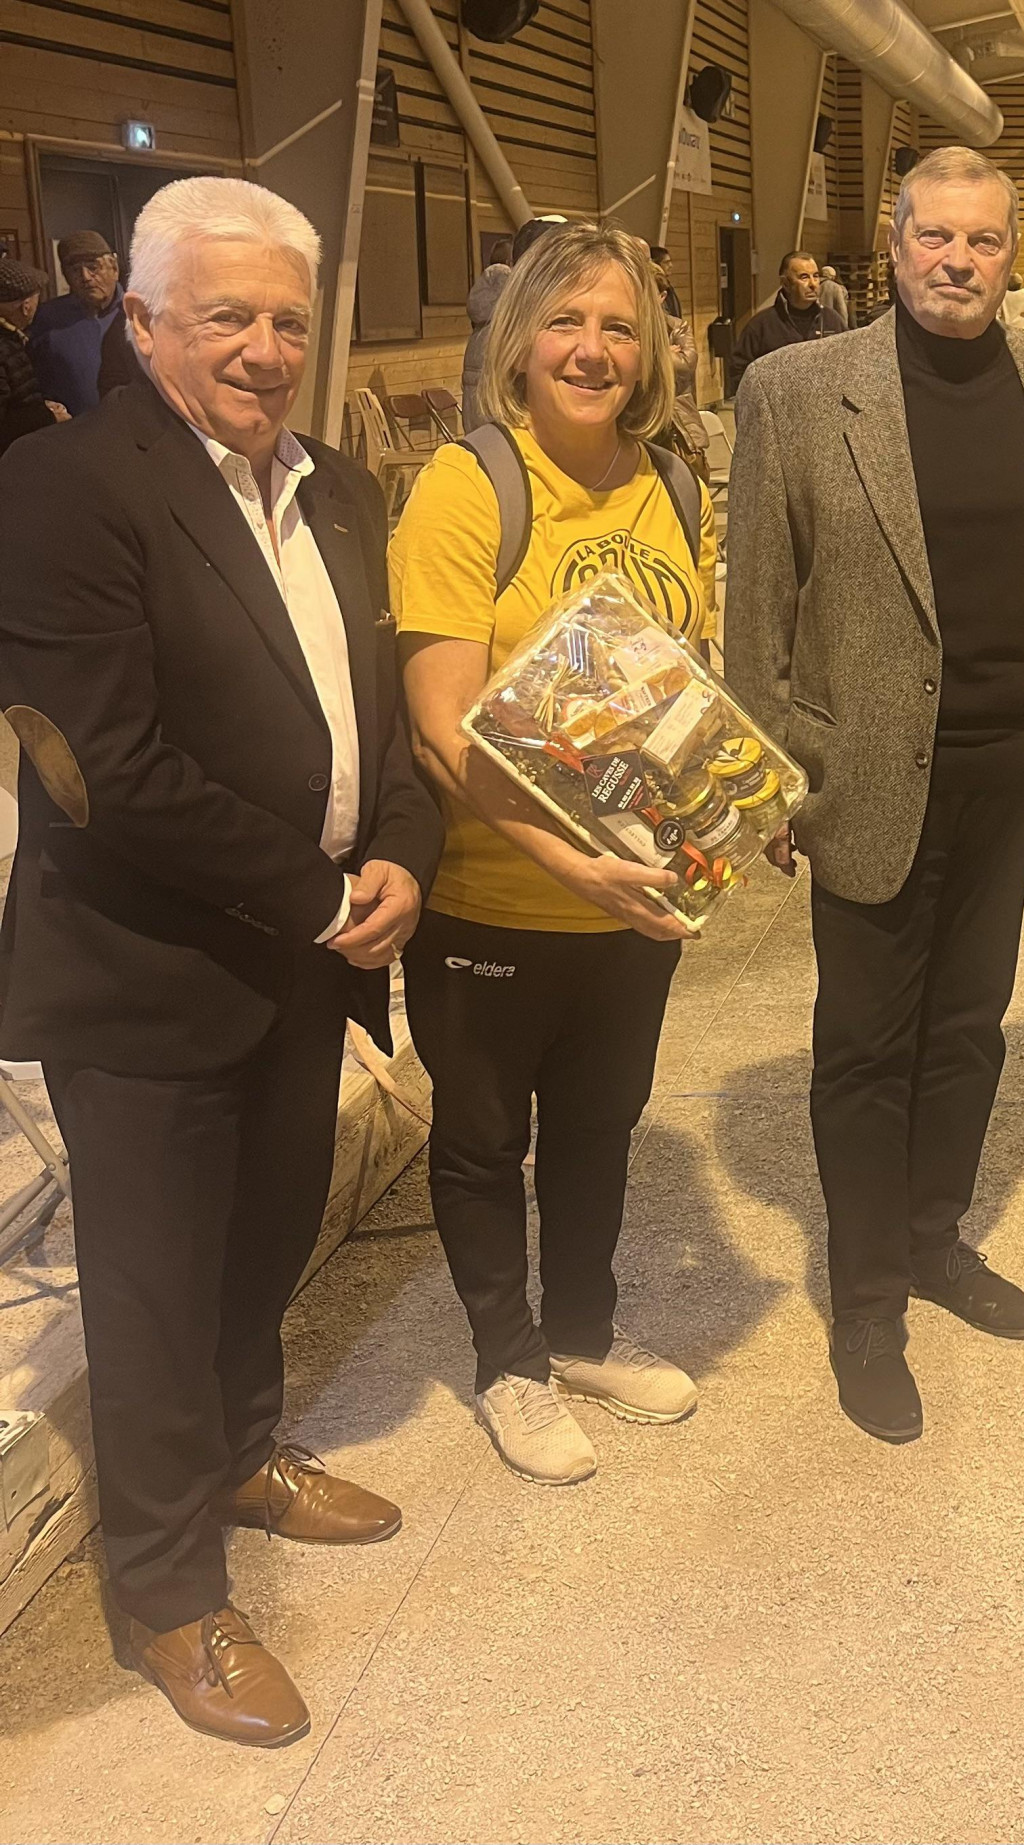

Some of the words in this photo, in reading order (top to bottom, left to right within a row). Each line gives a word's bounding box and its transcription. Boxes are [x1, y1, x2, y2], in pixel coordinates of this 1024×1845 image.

[576, 545, 596, 562] LA
[591, 784, 602, 798] LES
[598, 765, 614, 786] CAVES
[610, 756, 621, 767] DE
[597, 760, 629, 803] REGUSSE
[473, 961, 515, 977] eldera
